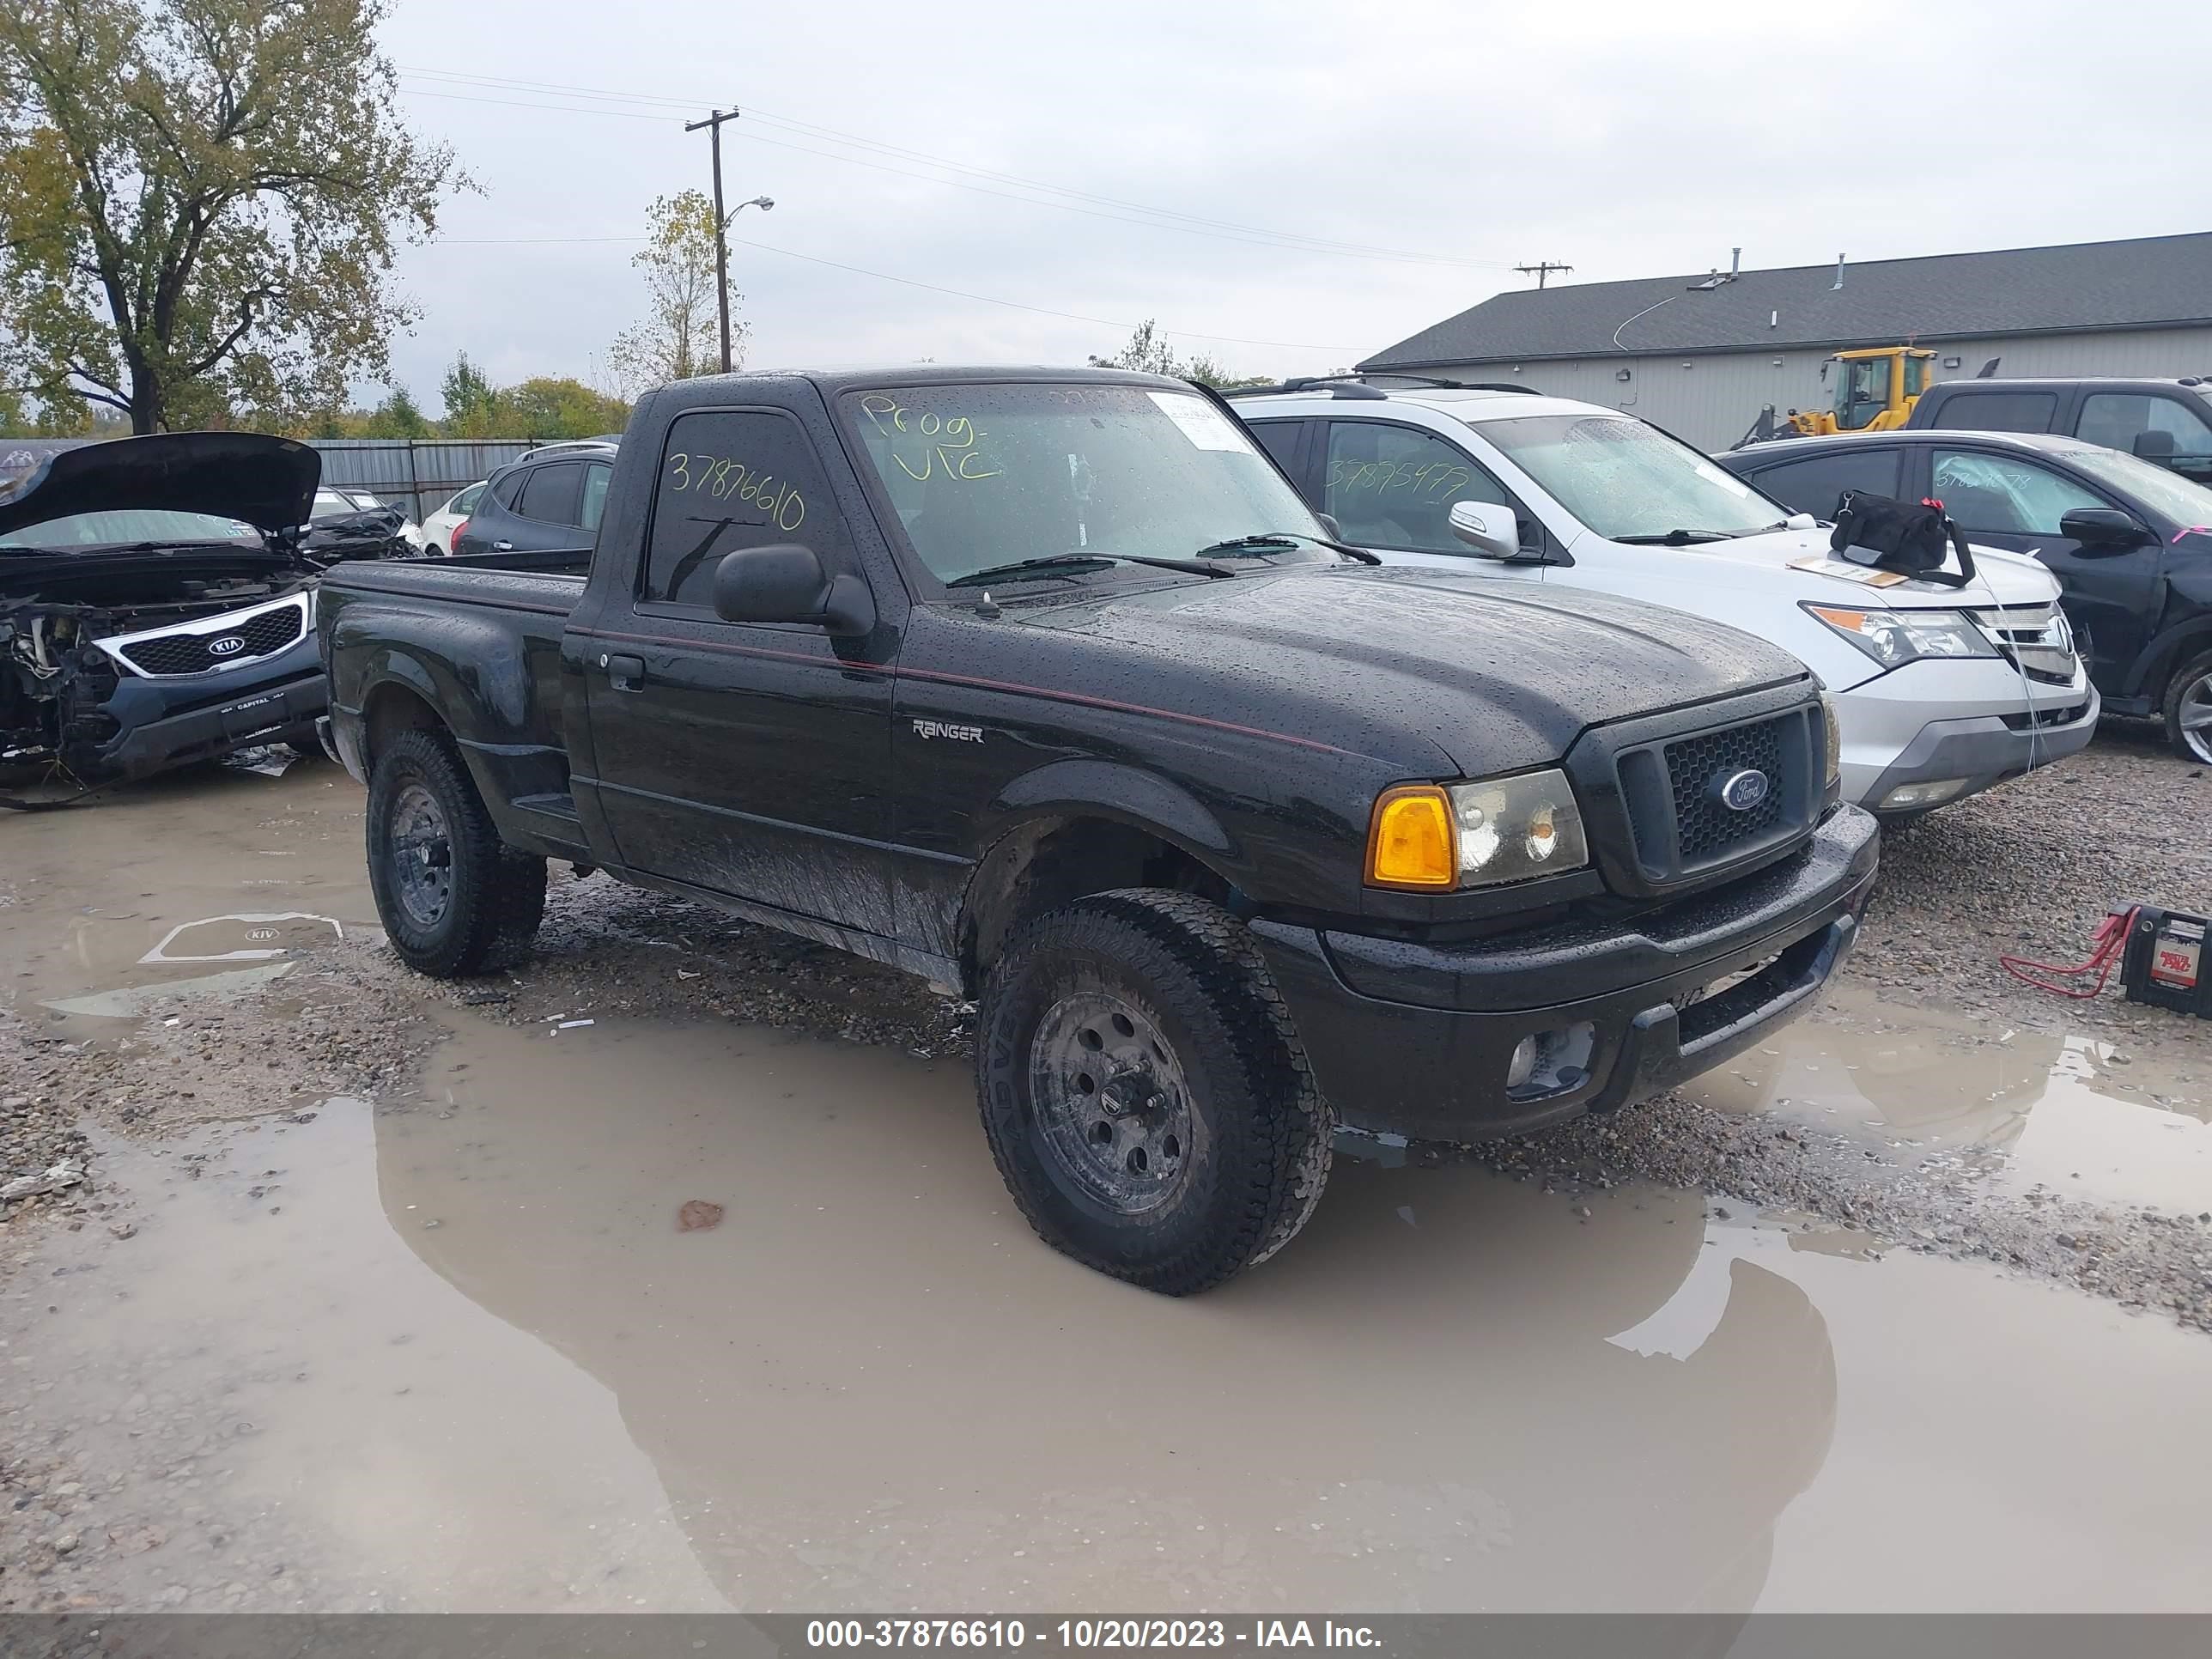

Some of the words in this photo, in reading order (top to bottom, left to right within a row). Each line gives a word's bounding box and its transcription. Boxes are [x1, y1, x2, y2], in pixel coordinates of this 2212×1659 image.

[670, 453, 805, 532] 37876610
[215, 641, 240, 653] KIA
[237, 697, 270, 710] CAPITAL
[913, 719, 986, 744] RANGER
[1736, 778, 1760, 803] Ford
